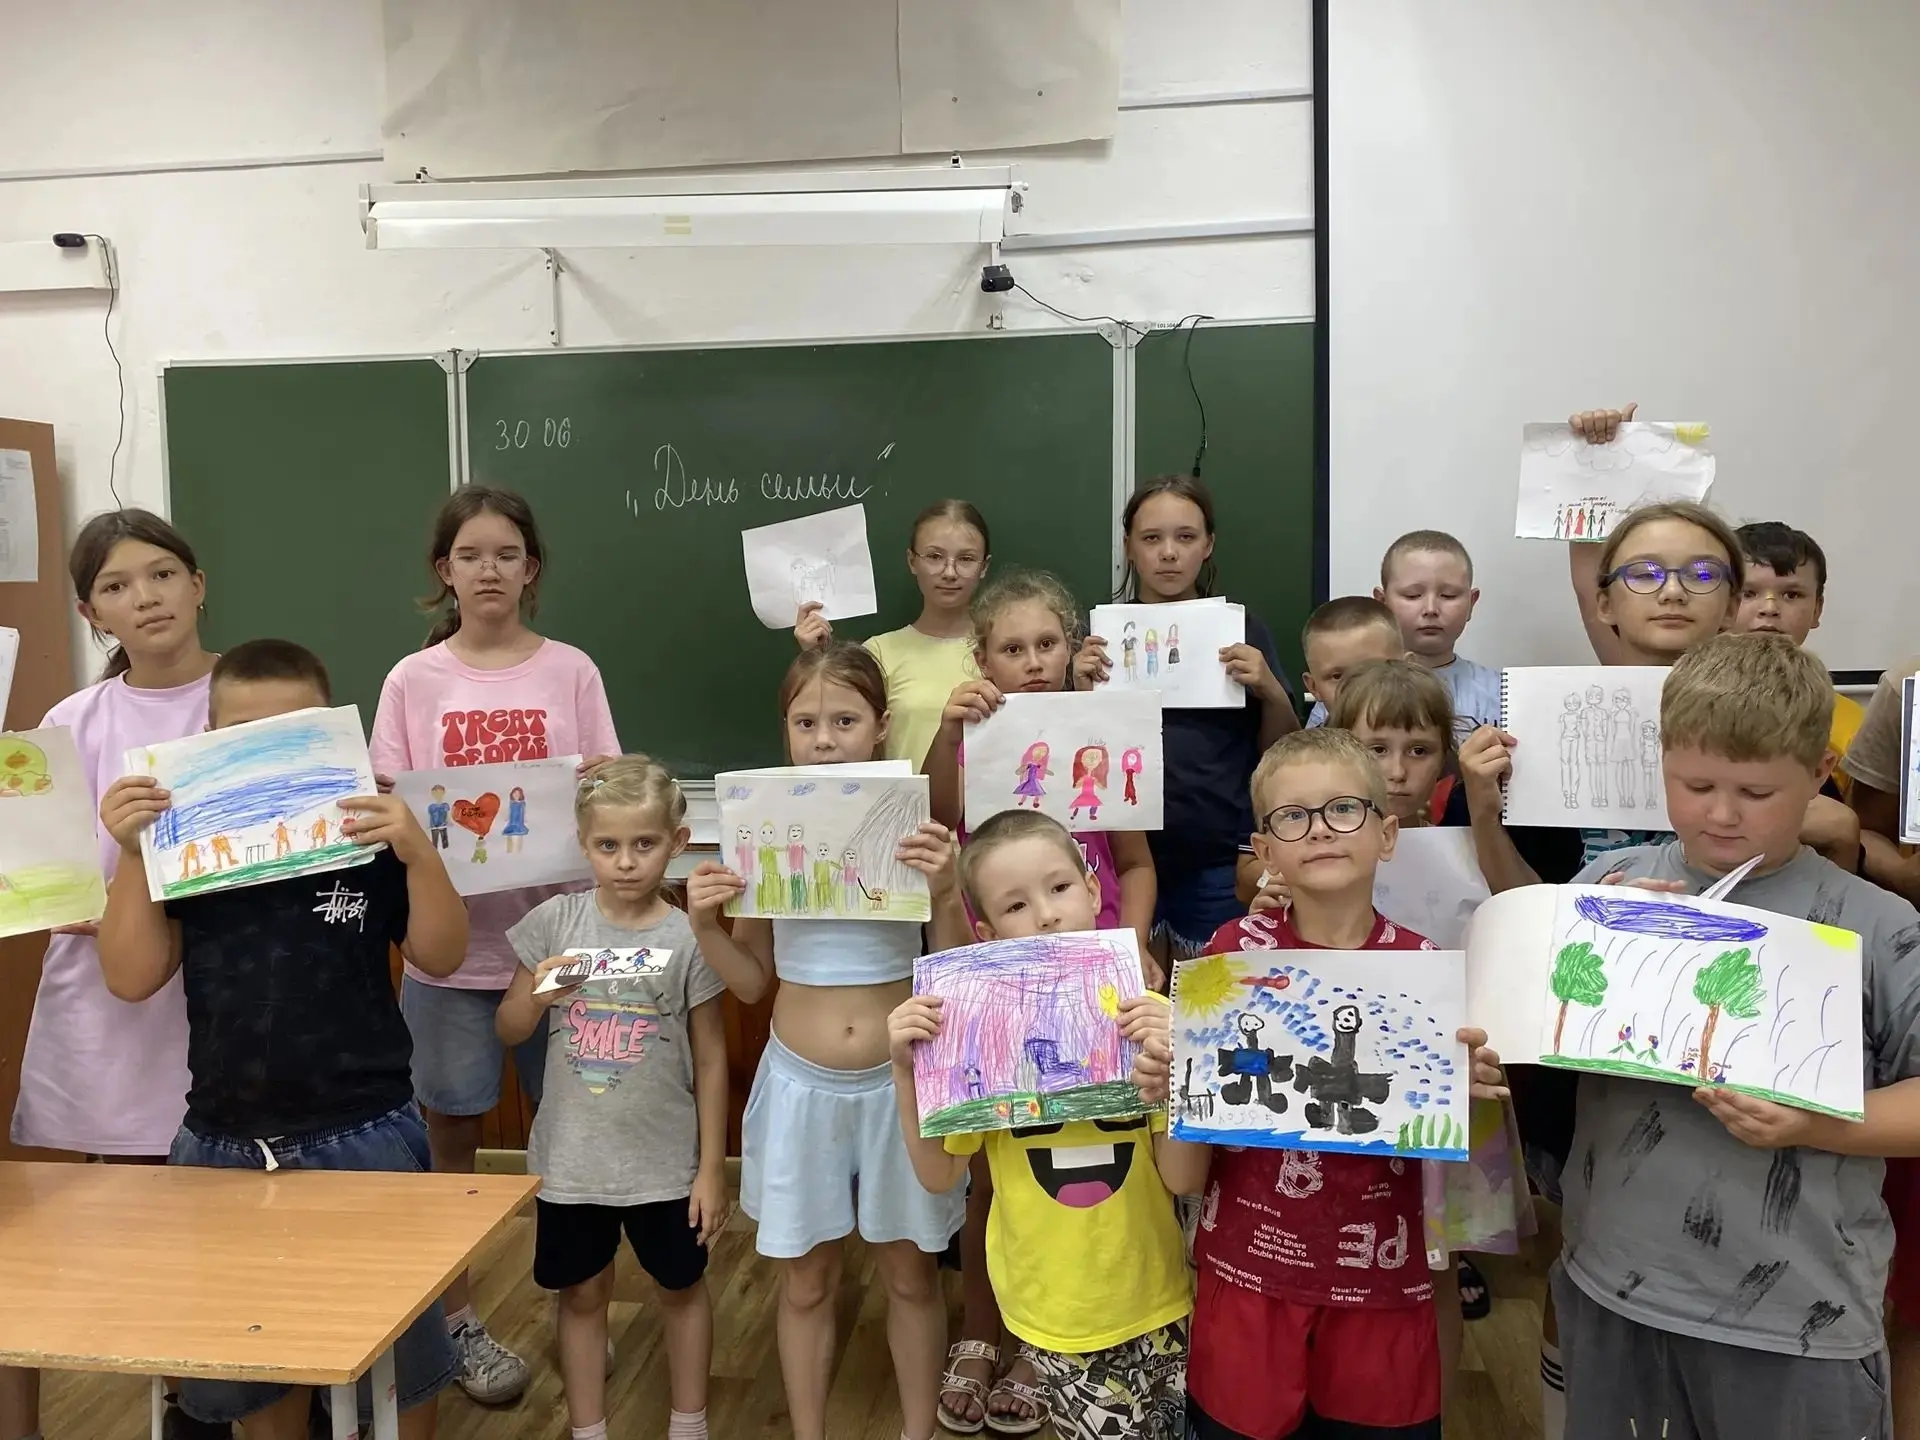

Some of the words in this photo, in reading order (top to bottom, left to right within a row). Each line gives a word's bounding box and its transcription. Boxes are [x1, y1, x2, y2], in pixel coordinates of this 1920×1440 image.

[495, 419, 530, 450] 30
[442, 709, 547, 753] TREAT
[608, 981, 618, 995] &
[568, 1000, 649, 1060] SMILE
[1254, 1229, 1270, 1240] How
[1272, 1235, 1282, 1244] To
[1283, 1238, 1306, 1249] Share
[1261, 1223, 1275, 1233] Will
[1276, 1228, 1298, 1240] Know
[1247, 1245, 1273, 1259] Double
[1237, 1268, 1262, 1284] Double
[1331, 1293, 1345, 1301] Get
[1345, 1294, 1364, 1303] ready
